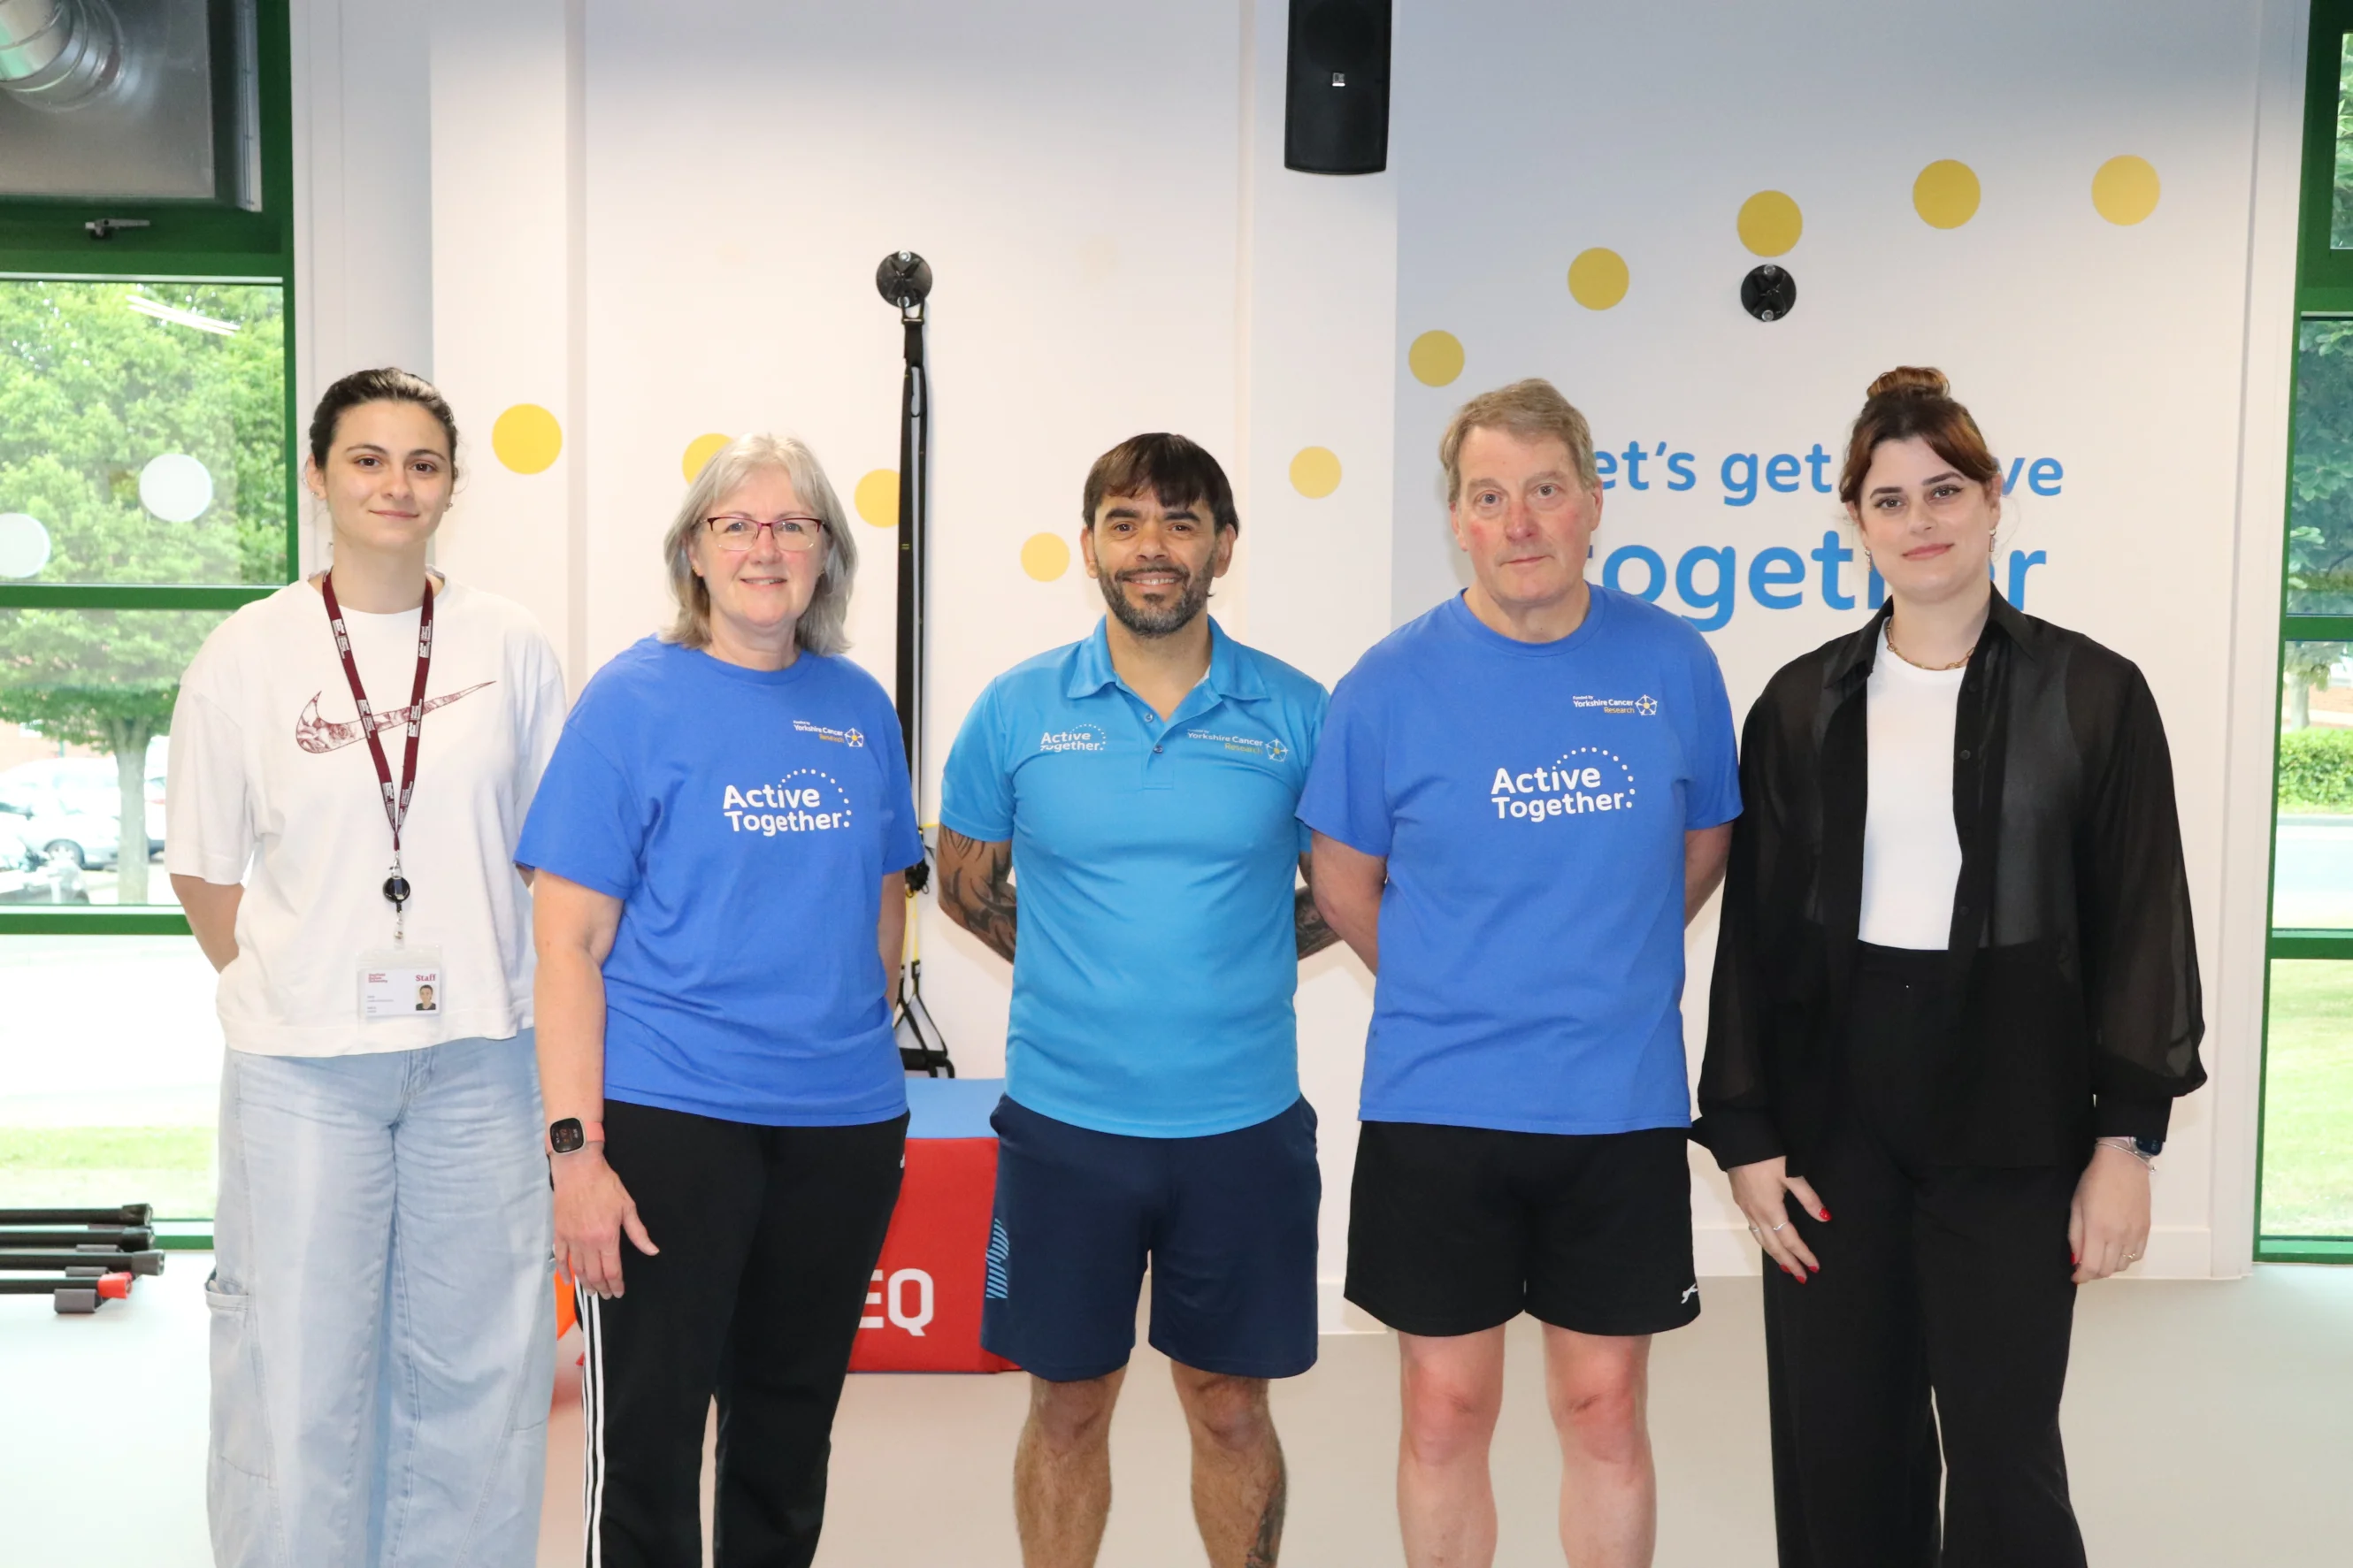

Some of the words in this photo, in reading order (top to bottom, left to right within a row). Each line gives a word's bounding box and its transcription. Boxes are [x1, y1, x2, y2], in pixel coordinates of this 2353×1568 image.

[1593, 440, 1697, 492] et's
[1721, 444, 1832, 506] get
[1586, 530, 2046, 632] ogetr
[793, 724, 823, 733] Yorkshire
[1040, 730, 1091, 745] Active
[1188, 732, 1230, 742] Yorkshire
[1231, 736, 1264, 746] Cancer
[1491, 767, 1601, 794] Active
[723, 784, 820, 809] Active
